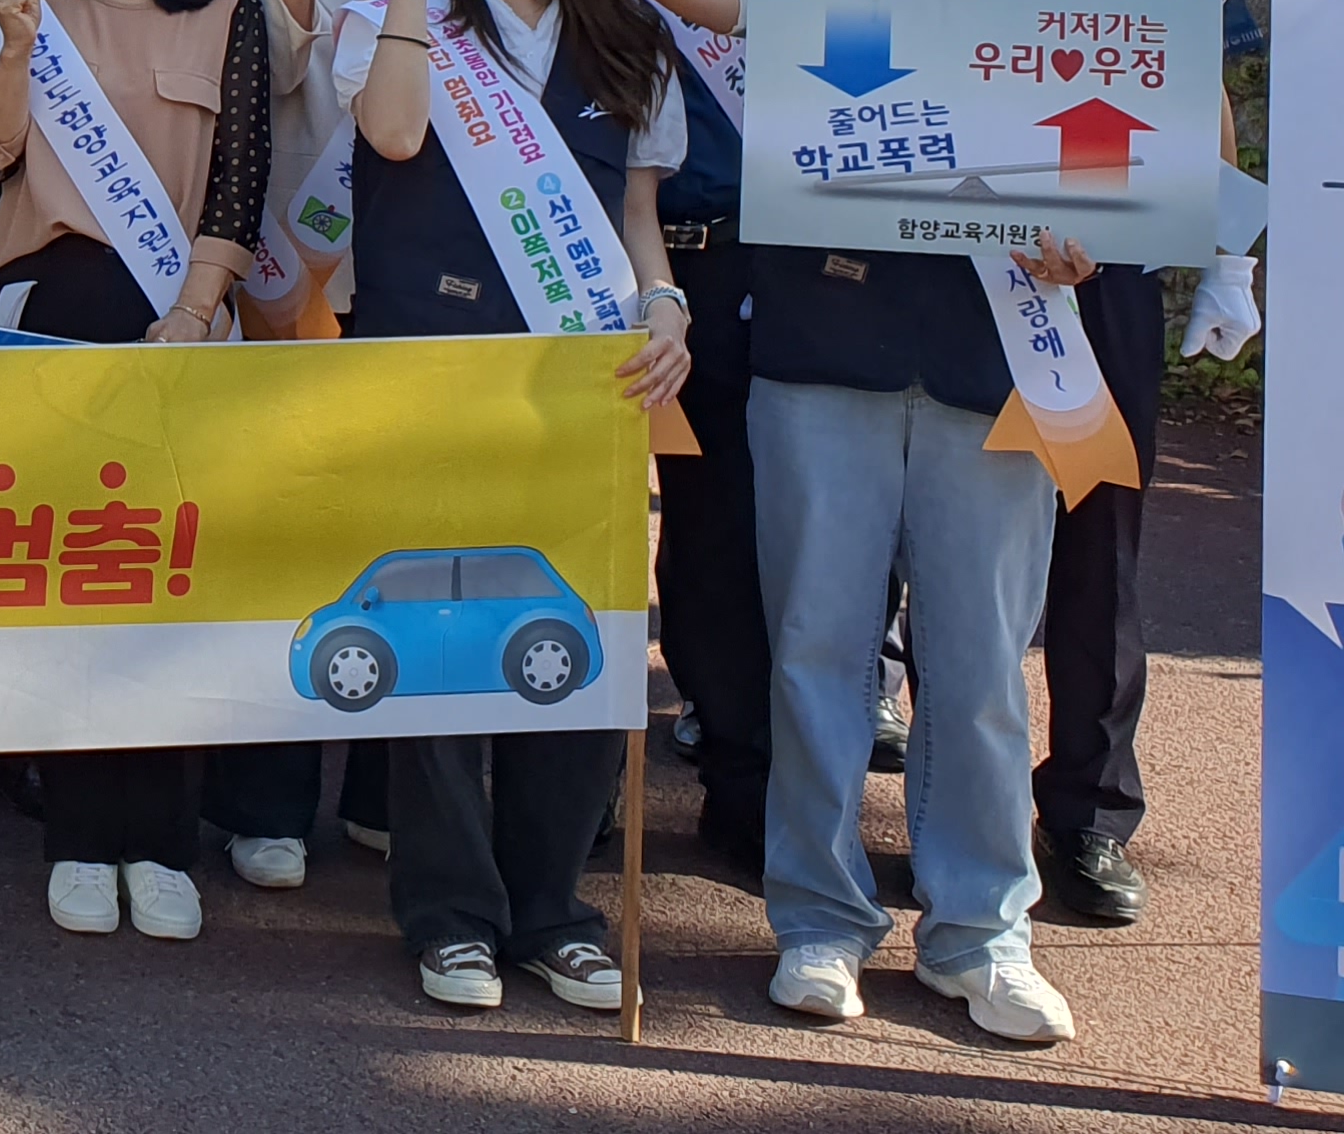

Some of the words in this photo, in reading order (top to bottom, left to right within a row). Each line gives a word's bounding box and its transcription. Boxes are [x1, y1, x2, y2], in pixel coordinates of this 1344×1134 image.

[1037, 10, 1170, 45] 커져가는
[969, 42, 1044, 84] 우리
[1089, 47, 1167, 90] 우정
[443, 75, 496, 148] 멈춰요
[489, 92, 546, 166] 기다려요
[827, 99, 951, 137] 줄어드는
[792, 131, 957, 182] 학교폭력
[511, 208, 574, 304] 이쪽저쪽
[548, 194, 583, 237] 사고
[566, 237, 603, 280] 예방
